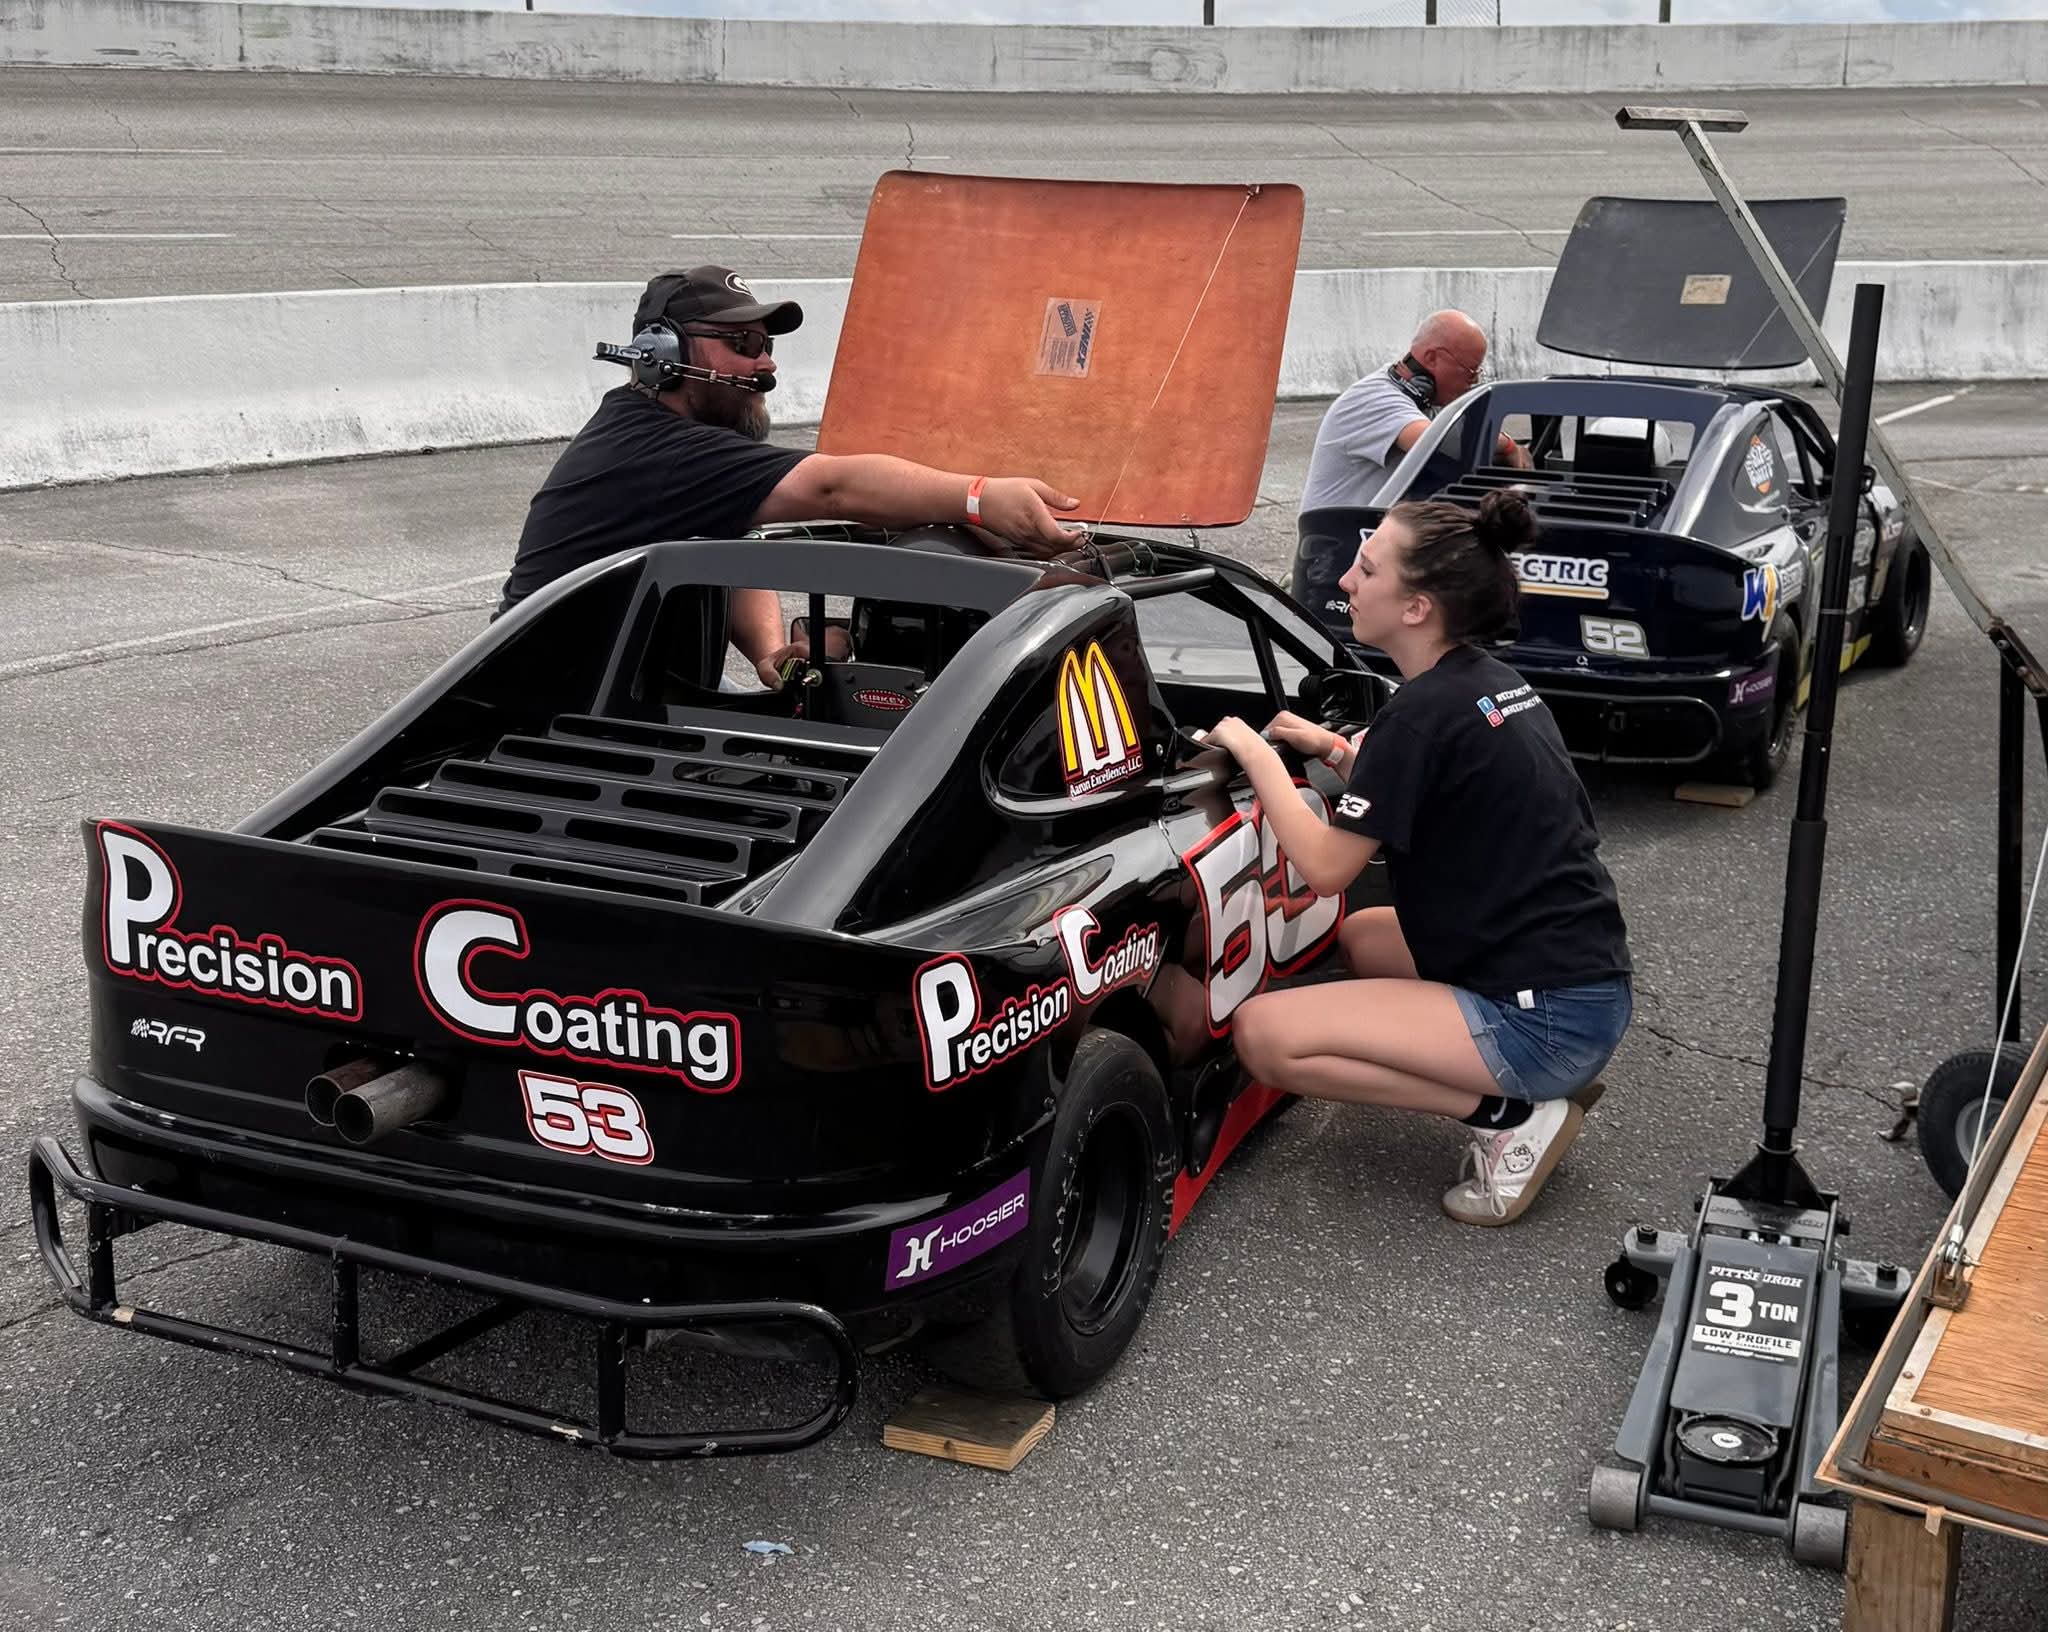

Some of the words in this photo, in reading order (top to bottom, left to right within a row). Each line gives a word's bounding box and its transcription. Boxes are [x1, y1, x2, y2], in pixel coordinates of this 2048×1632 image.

[1509, 556, 1605, 583] ECTRIC
[1584, 619, 1645, 654] 52
[859, 693, 905, 705] KIRKEY
[1069, 781, 1091, 798] Aaron
[1195, 788, 1342, 1023] 53
[102, 830, 355, 1012] Precision
[424, 909, 730, 1084] Coating
[919, 960, 1068, 1082] Precision
[1060, 908, 1157, 995] Coating
[149, 1022, 206, 1053] RFR
[527, 1076, 649, 1160] 53
[940, 1192, 1026, 1252] HOOSIER
[1705, 1280, 1755, 1328] 3
[1757, 1300, 1798, 1323] TON
[1701, 1327, 1733, 1339] LOW
[1736, 1332, 1793, 1349] PROFILE
